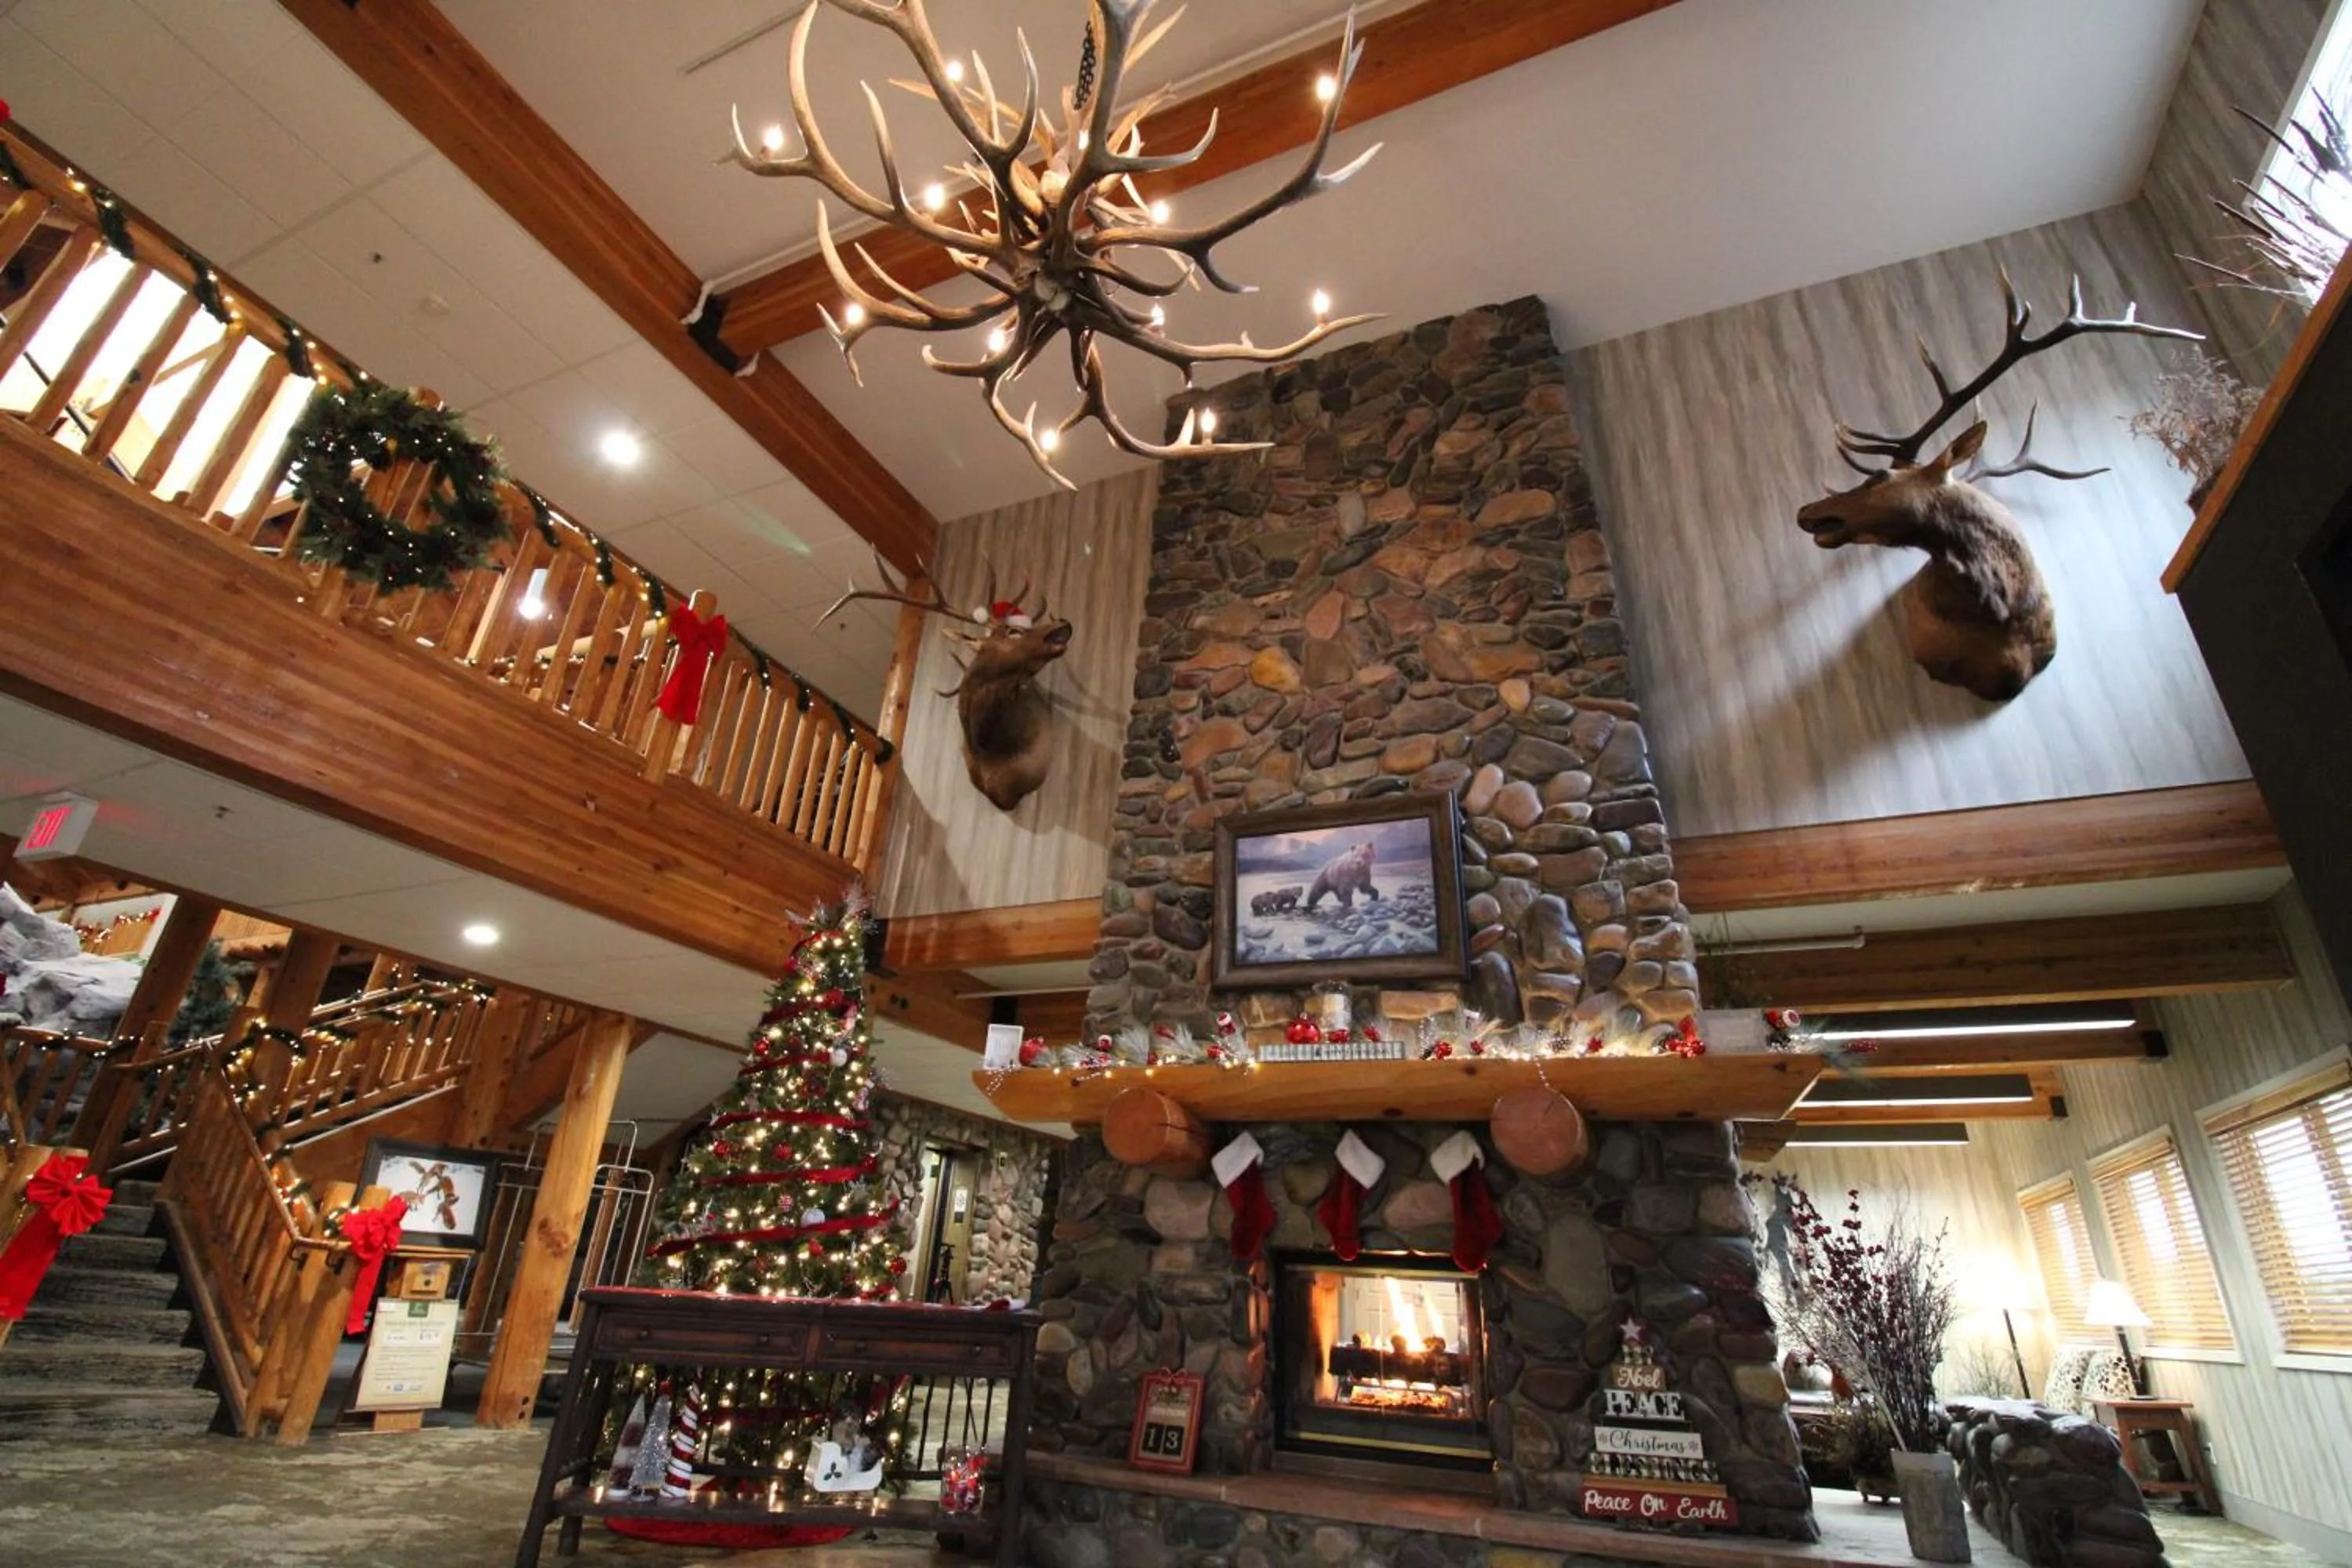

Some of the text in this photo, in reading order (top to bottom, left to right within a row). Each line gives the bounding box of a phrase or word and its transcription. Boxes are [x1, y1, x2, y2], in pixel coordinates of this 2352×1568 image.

[25, 803, 74, 849] EXIT
[1617, 1367, 1661, 1388] Noel
[1604, 1389, 1685, 1421] PEACE
[1610, 1429, 1688, 1450] Christmas
[1584, 1490, 1730, 1520] Peace On Earth
